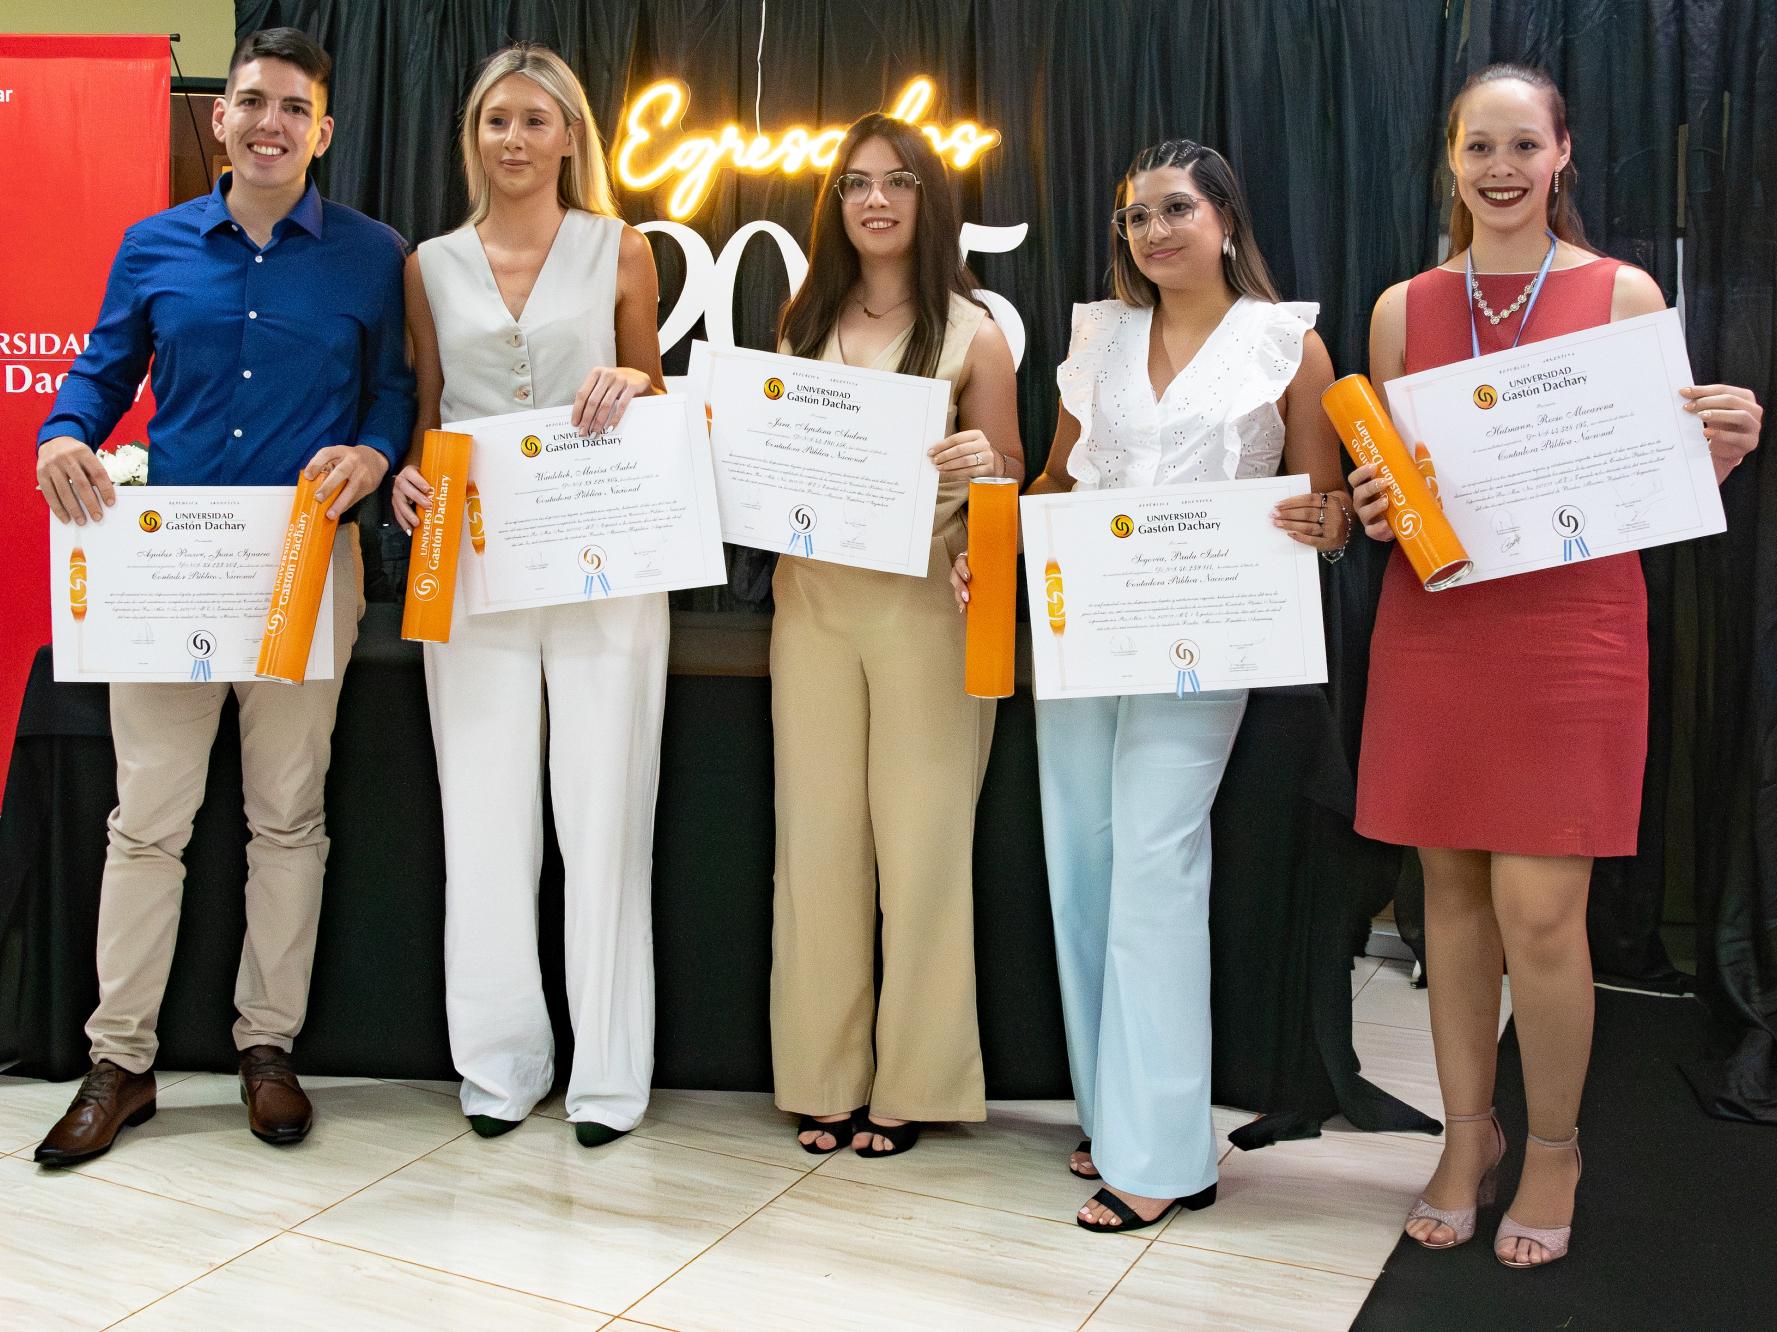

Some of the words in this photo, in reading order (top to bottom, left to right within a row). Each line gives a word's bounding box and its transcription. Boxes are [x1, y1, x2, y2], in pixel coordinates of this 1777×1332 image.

[618, 75, 1000, 221] Egresas
[634, 219, 1029, 373] 205
[1509, 366, 1572, 388] UNIVERSIDAD
[796, 384, 851, 399] UNIVERSIDAD
[1502, 386, 1540, 402] Gastón
[1542, 376, 1588, 392] Dachary
[787, 391, 819, 405] Gastón
[822, 397, 861, 413] Dachary
[545, 441, 579, 452] Gastón
[582, 436, 622, 447] Dachary
[1353, 419, 1383, 465] Dachary
[434, 474, 451, 525] Dachary
[165, 520, 201, 530] Gastón
[204, 520, 246, 532] Dachary
[175, 512, 234, 520] UNIVERSIDAD
[1138, 523, 1175, 534] Gastón
[1178, 520, 1221, 532] Dachary
[1146, 511, 1207, 522] UNIVERSIDAD
[289, 511, 311, 563] Dachary
[428, 529, 443, 570] Gastón
